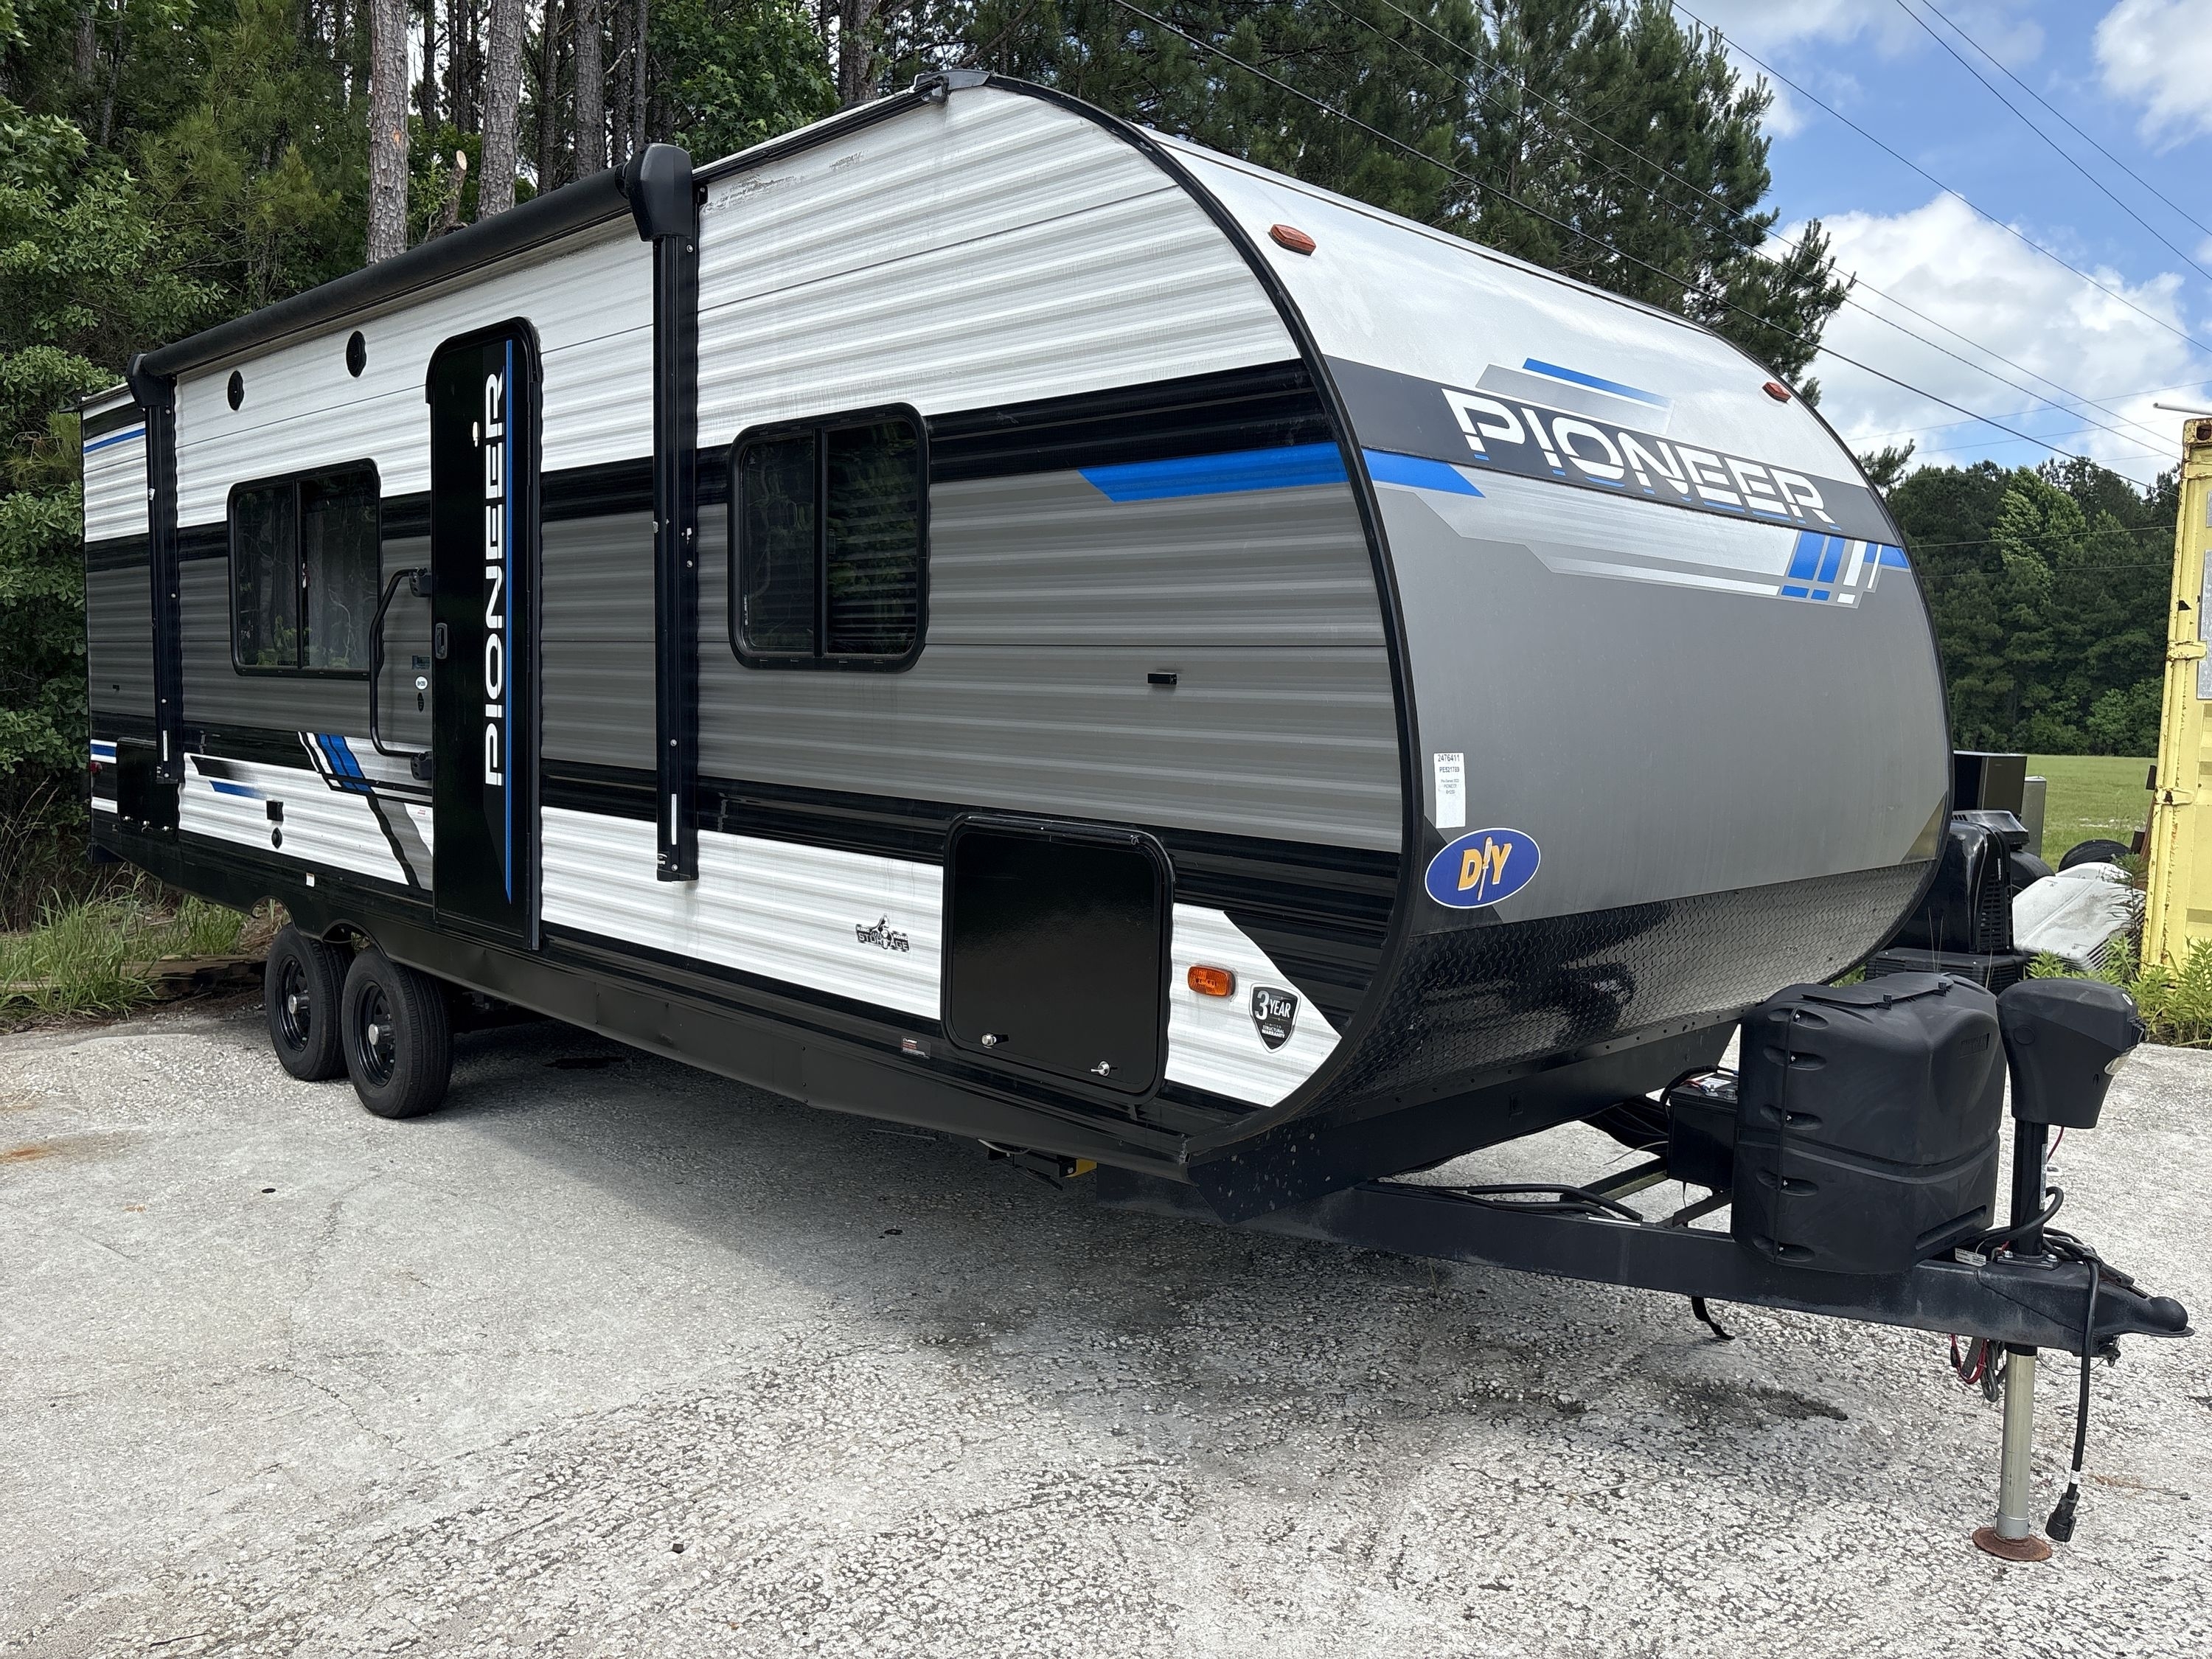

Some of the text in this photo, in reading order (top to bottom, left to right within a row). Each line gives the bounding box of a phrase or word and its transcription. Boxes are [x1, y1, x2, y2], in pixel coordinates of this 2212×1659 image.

[1441, 388, 1840, 529] PIONEER
[484, 370, 504, 787] PIONEER
[1438, 754, 1460, 762] 2476411
[1254, 990, 1292, 1020] 3 YEAR
[1262, 1024, 1284, 1034] STRUCTURAL
[1262, 1029, 1286, 1039] WARRANTY
